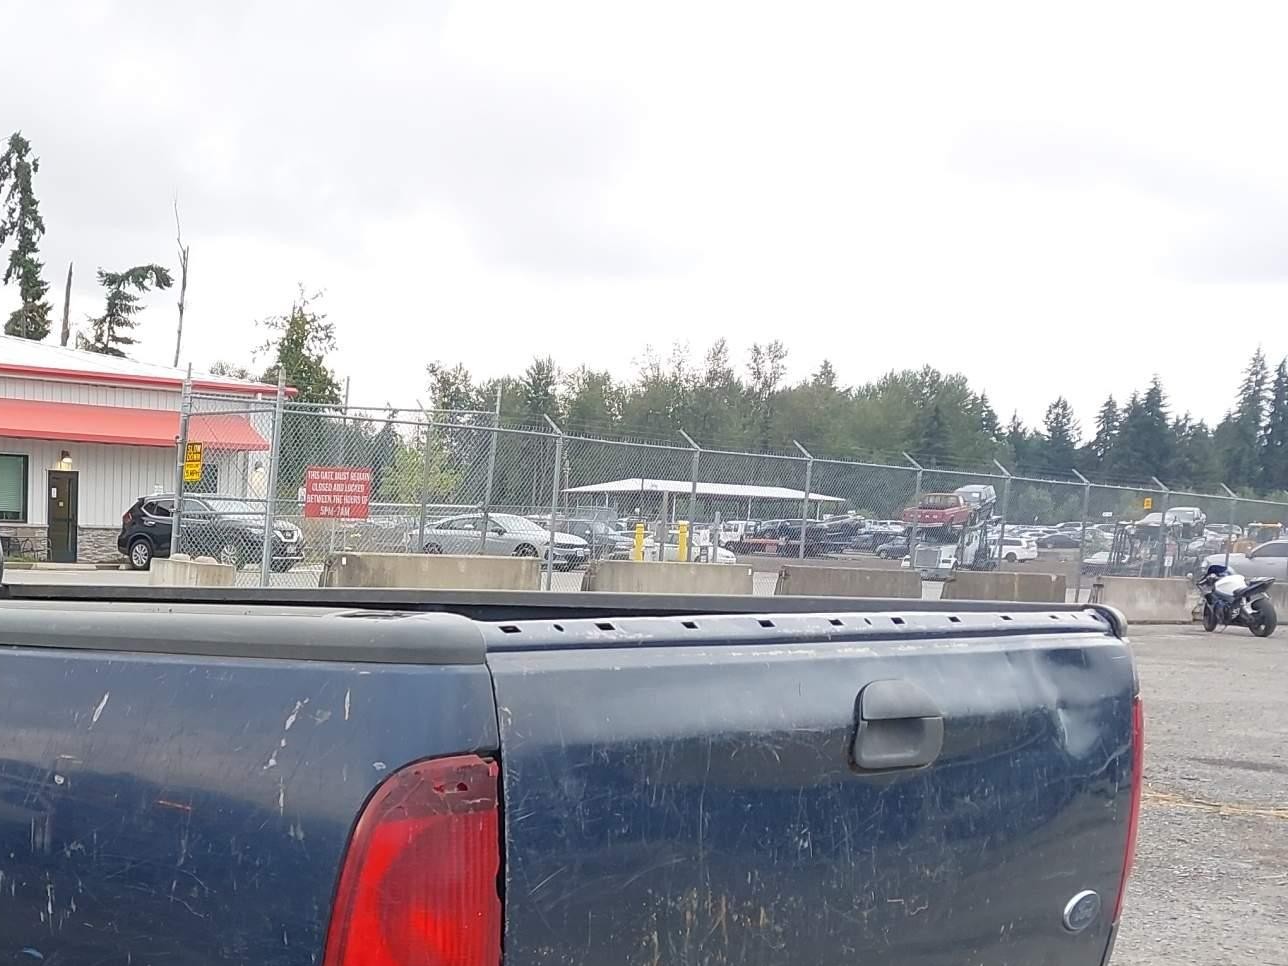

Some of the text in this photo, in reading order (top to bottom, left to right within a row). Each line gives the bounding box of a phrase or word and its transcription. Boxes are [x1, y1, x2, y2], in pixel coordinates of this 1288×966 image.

[308, 470, 320, 480] THIS
[320, 471, 333, 480] GATE
[334, 471, 349, 480] MUST
[312, 483, 365, 492] CLOSED AND LOCKED
[306, 494, 369, 504] BETWEEN THE HOURS OF
